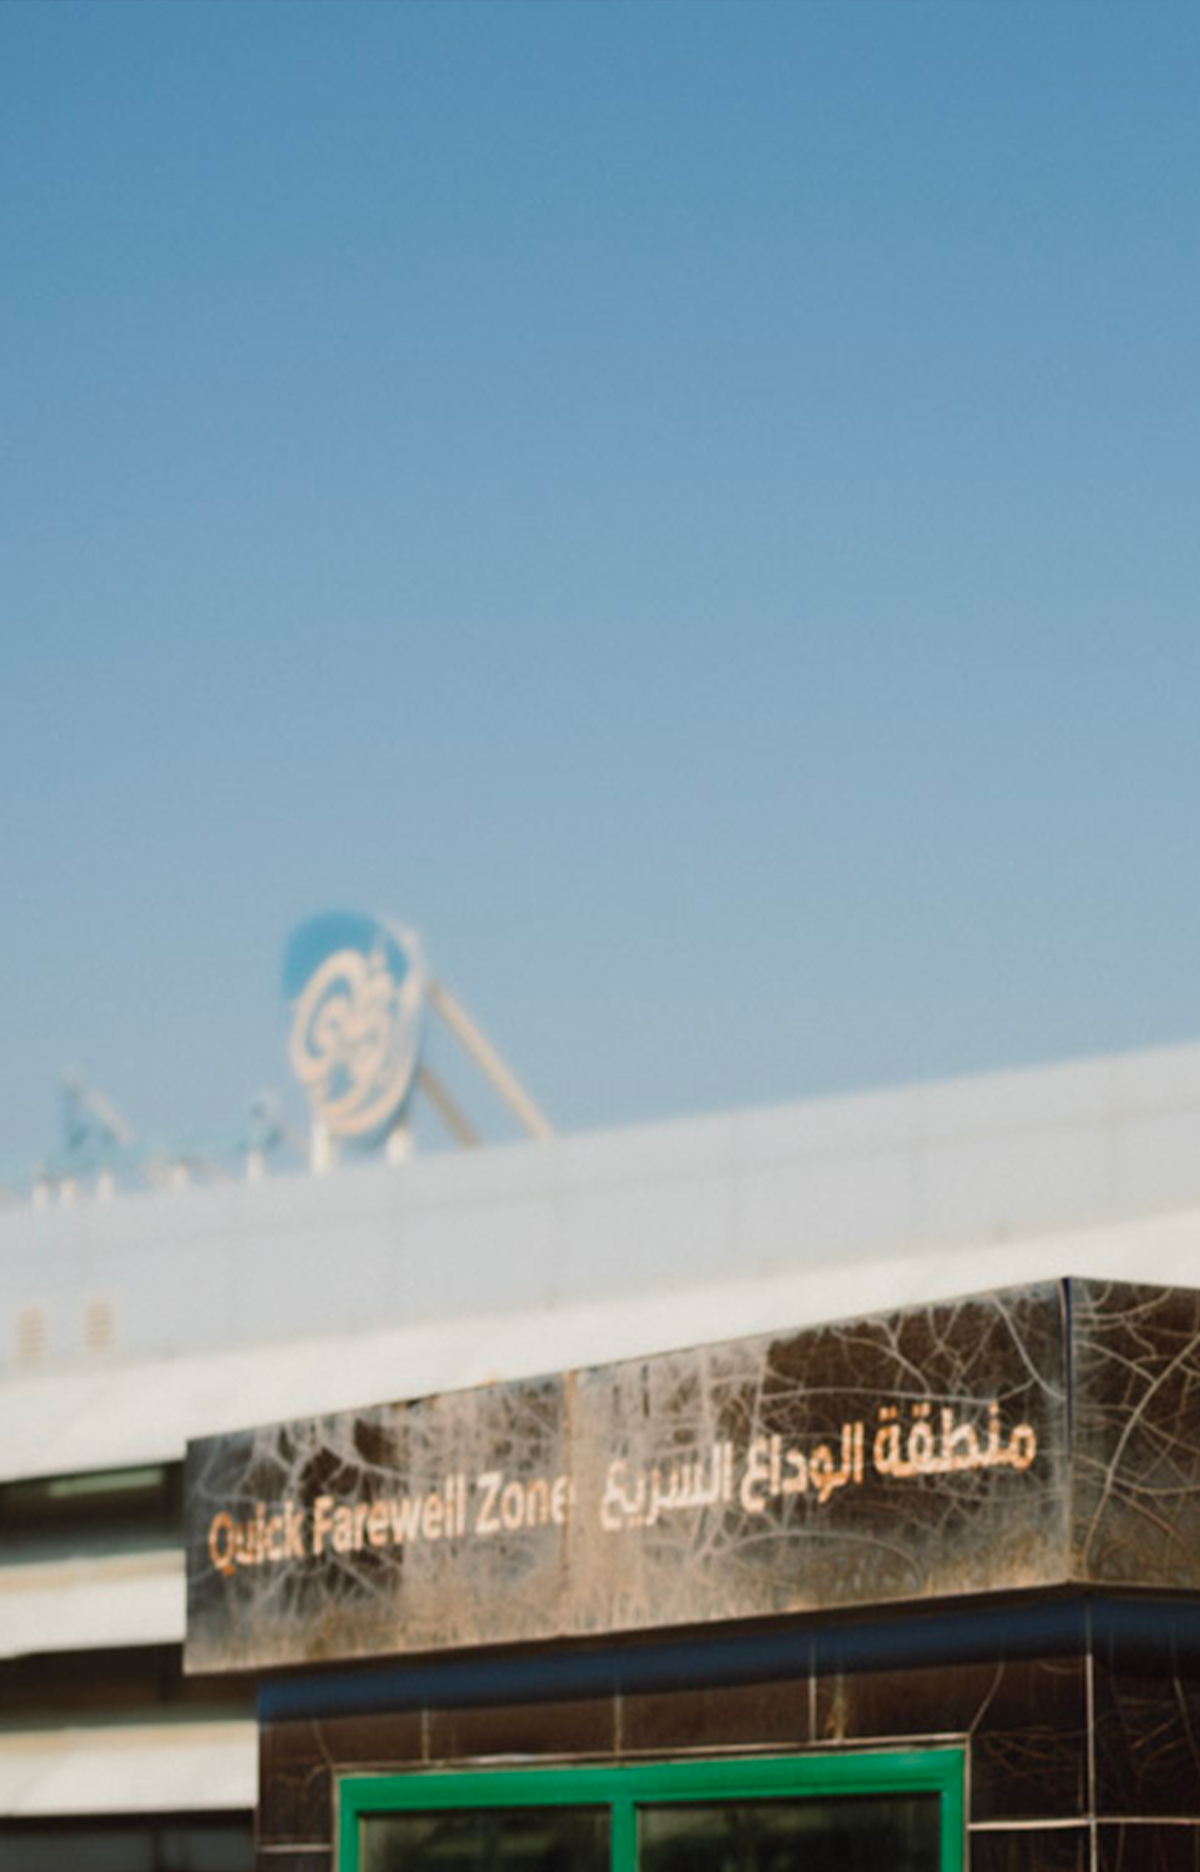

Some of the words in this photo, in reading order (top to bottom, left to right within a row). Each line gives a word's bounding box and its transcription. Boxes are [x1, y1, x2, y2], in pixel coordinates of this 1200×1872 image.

[740, 1422, 864, 1512] الوداع
[873, 1401, 1038, 1478] منطقة
[208, 1501, 304, 1577] Quick
[313, 1472, 466, 1556] Farewell
[475, 1471, 576, 1534] Zone
[600, 1440, 733, 1530] السريع
